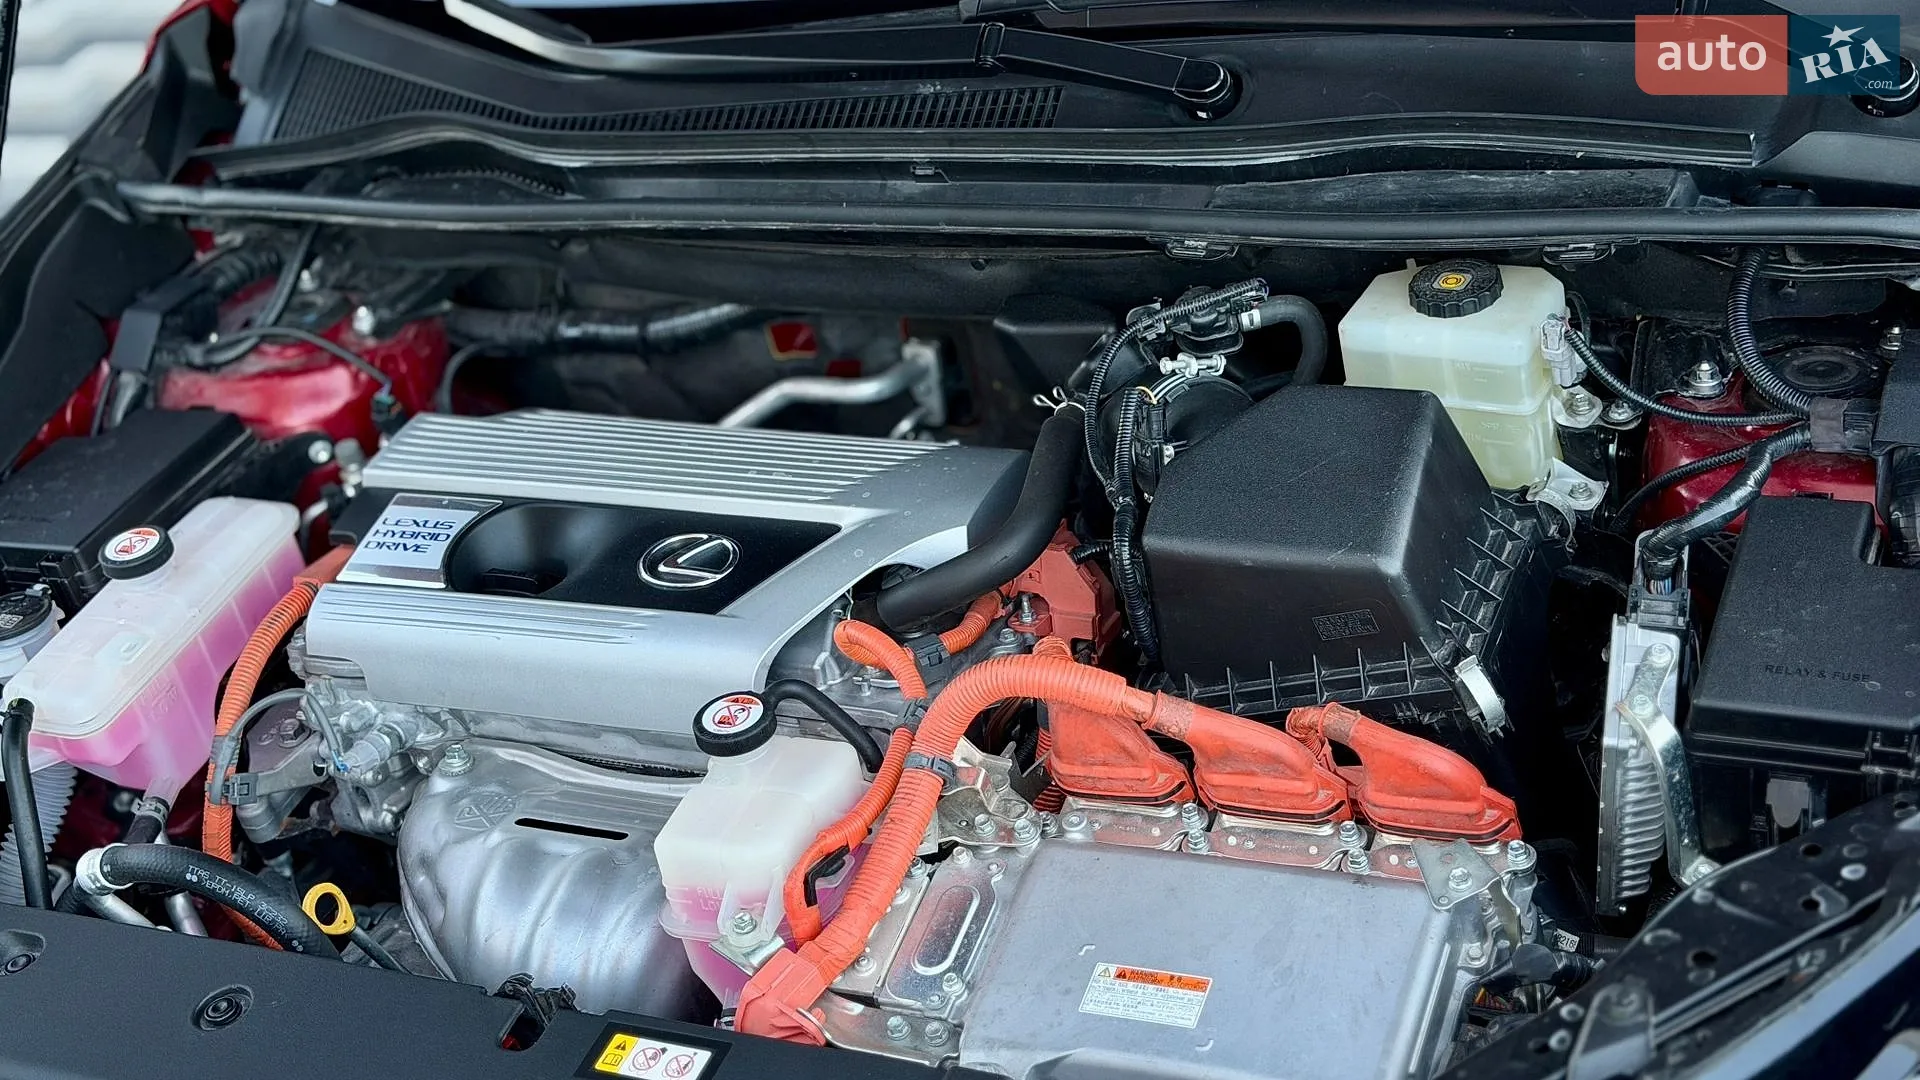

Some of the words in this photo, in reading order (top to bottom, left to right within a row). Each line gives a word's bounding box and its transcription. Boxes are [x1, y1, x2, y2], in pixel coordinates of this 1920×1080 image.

[382, 518, 456, 530] LEXUS
[372, 529, 452, 542] HYBRID
[364, 541, 432, 553] DRIVE
[1764, 664, 1813, 678] RELAY
[1817, 670, 1828, 679] &
[1831, 671, 1871, 683] FUSE
